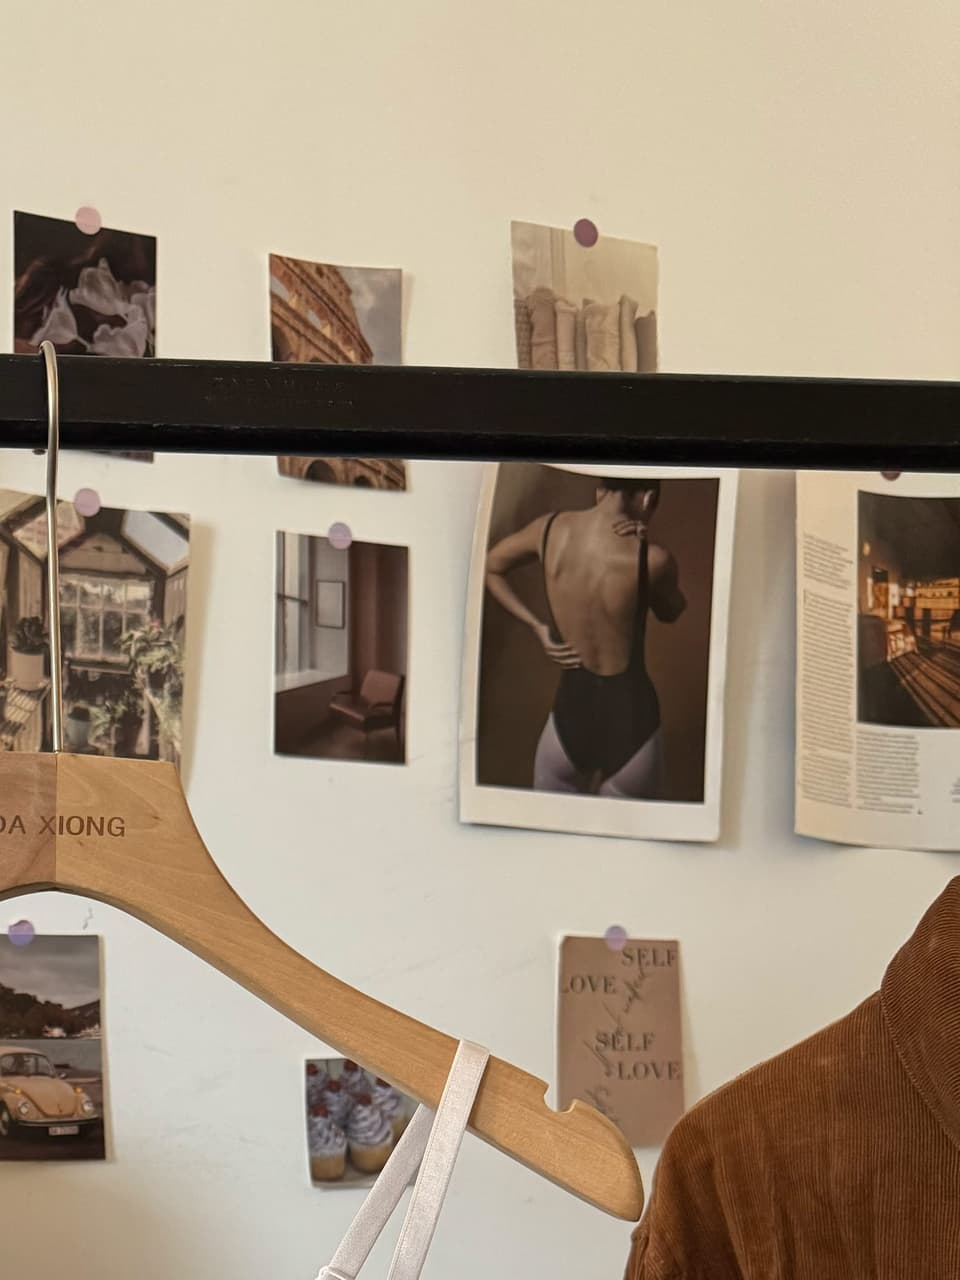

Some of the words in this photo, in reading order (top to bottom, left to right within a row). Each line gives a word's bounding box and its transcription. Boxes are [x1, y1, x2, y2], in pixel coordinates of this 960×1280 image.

[38, 815, 126, 837] XIONG
[621, 948, 678, 968] SELF
[561, 975, 617, 994] OVE
[594, 1032, 655, 1052] SELF
[617, 1061, 682, 1081] LOVE
